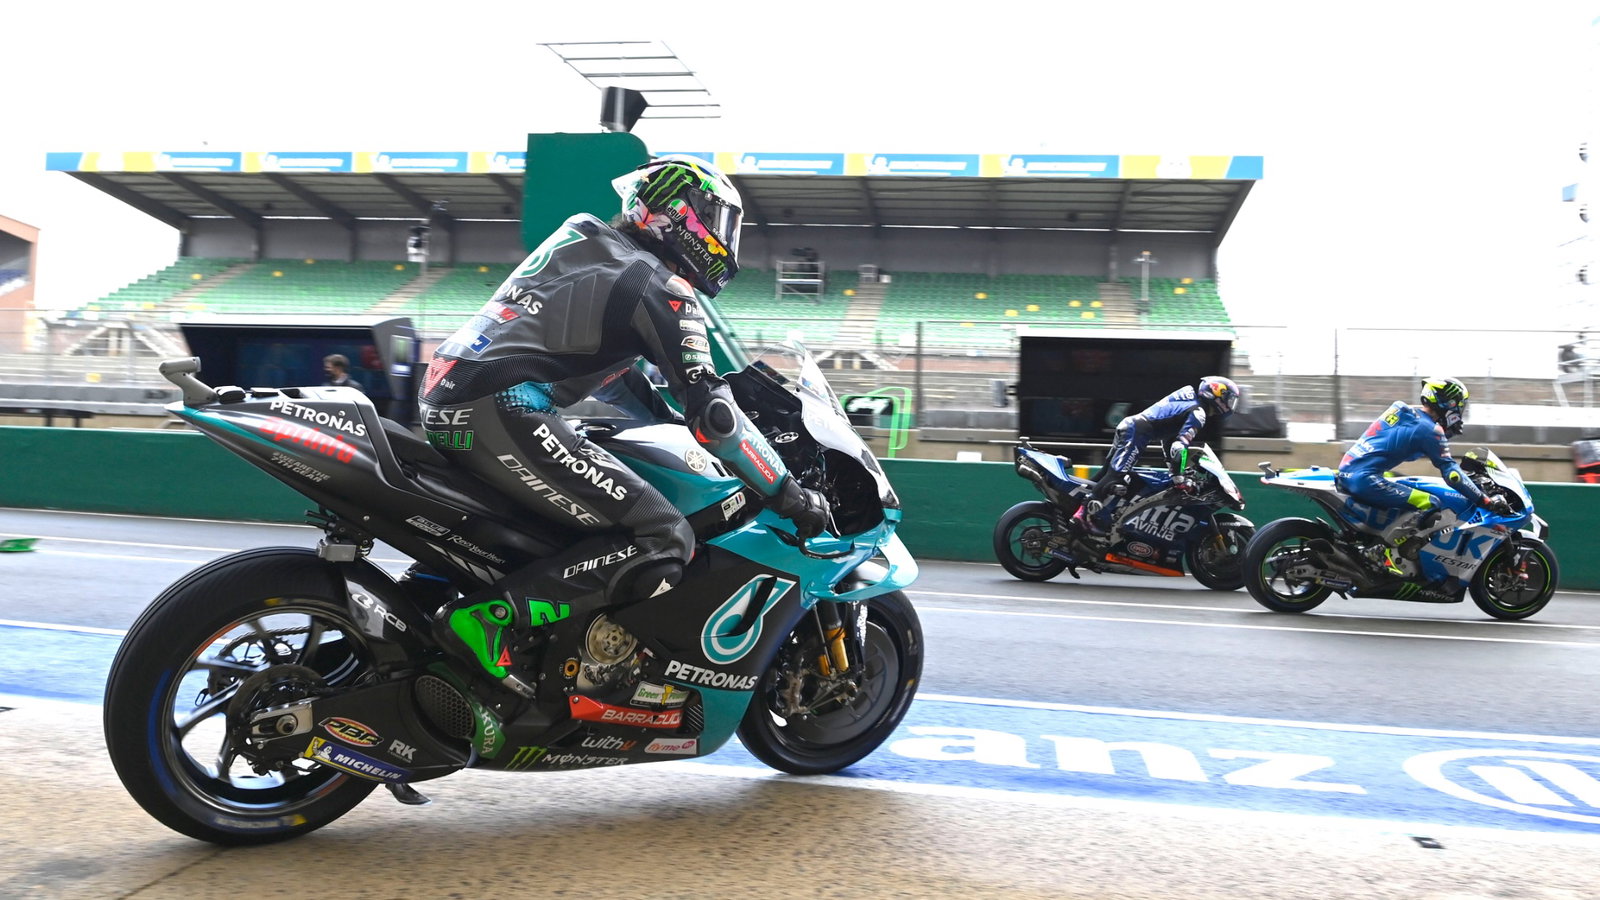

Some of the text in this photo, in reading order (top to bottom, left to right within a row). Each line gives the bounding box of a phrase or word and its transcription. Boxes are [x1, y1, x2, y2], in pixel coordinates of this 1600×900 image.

[269, 400, 366, 437] PETRONAS
[532, 423, 628, 501] PETRONAS
[741, 442, 774, 482] BARRACUDA
[497, 453, 600, 526] DAINESE
[1125, 515, 1176, 541] Avintia
[562, 544, 638, 579] DAINESE
[1434, 554, 1477, 571] ECSTAR
[373, 604, 408, 632] RCB
[664, 660, 758, 690] PETRONAS
[637, 687, 660, 699] Green
[323, 718, 382, 746] PBR
[389, 739, 417, 761] RK
[541, 753, 629, 766] MONSTER
[333, 753, 402, 779] MICHELIN
